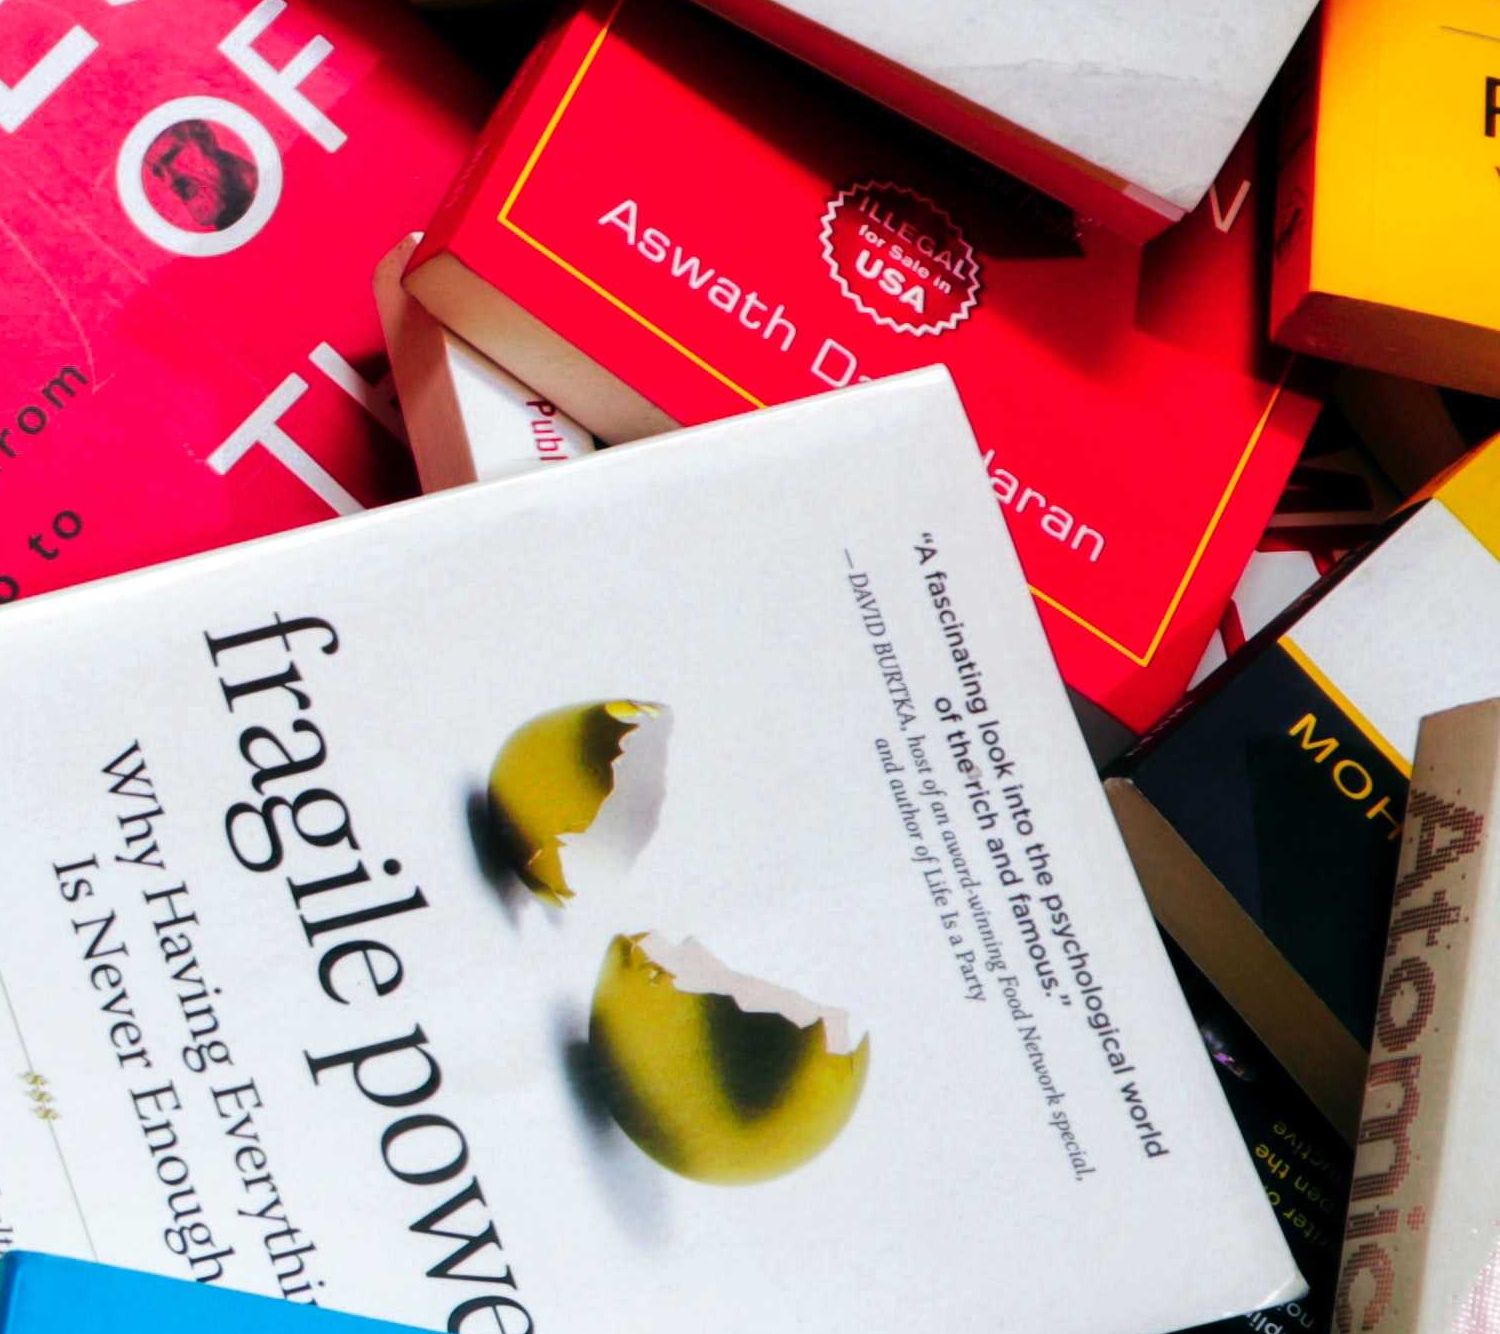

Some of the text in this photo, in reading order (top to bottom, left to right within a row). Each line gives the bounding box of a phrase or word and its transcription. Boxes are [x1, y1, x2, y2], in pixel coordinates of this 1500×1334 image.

[598, 199, 799, 356] Aswath
[858, 224, 952, 295] for Sale in
[859, 195, 970, 281] ILLEGAL
[856, 255, 926, 313] USA
[205, 610, 434, 1006] fragile
